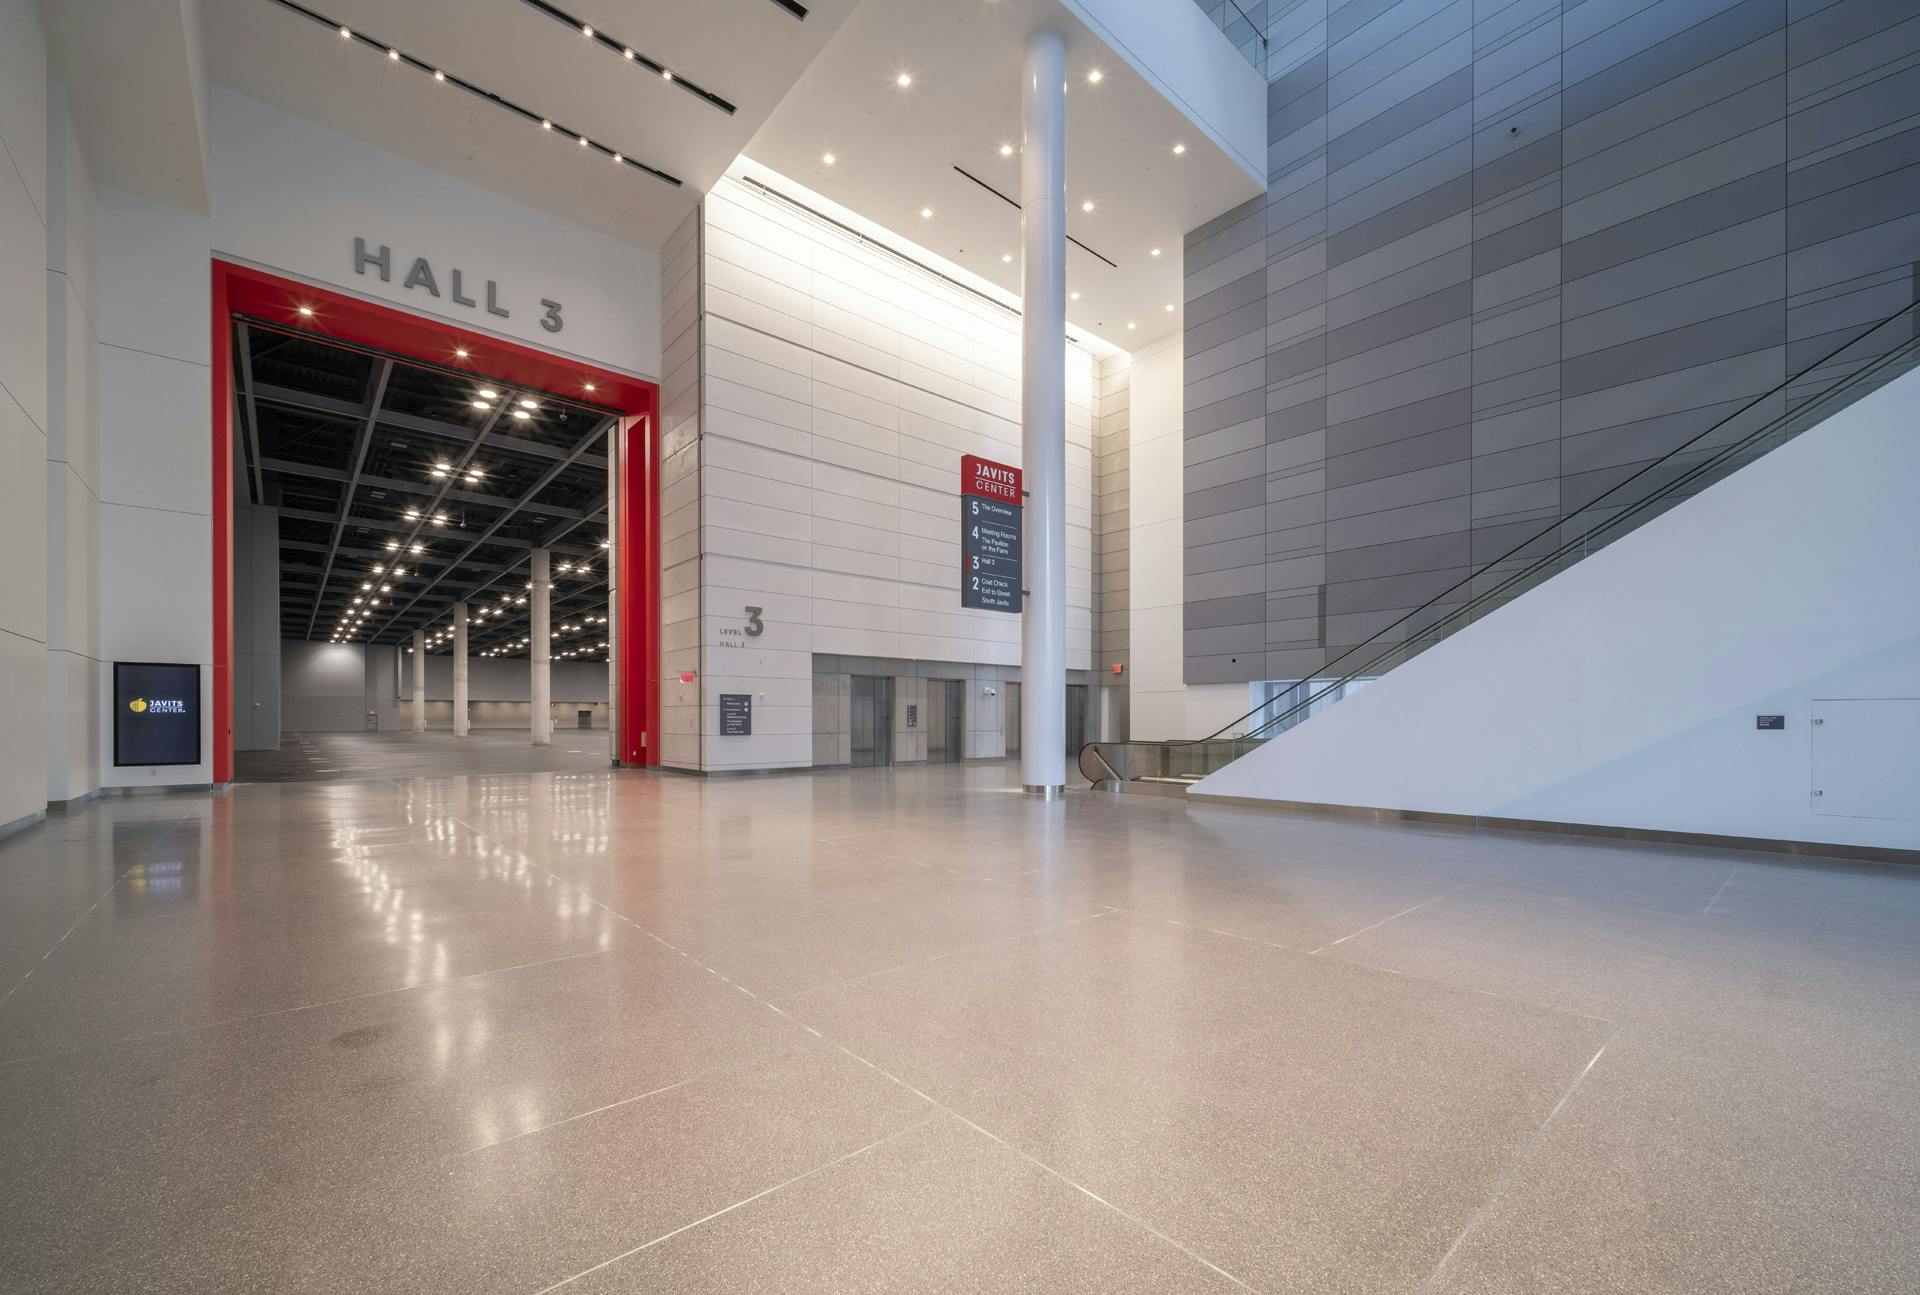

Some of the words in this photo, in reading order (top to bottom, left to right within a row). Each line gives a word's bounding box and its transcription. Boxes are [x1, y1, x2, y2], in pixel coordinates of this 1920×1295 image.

[354, 236, 510, 319] HALL
[540, 297, 563, 333] 3
[976, 463, 1015, 484] JAVITS
[976, 480, 1016, 499] CENTER
[972, 501, 979, 515] 5
[982, 503, 990, 511] The
[991, 505, 1012, 516] Overview
[972, 525, 979, 540] 4
[981, 527, 1000, 539] Meeting
[1000, 531, 1017, 540] Rooms
[981, 536, 991, 545] The
[972, 555, 980, 570] 3
[981, 557, 991, 565] Hall
[972, 576, 979, 591] 2
[981, 577, 993, 586] Coat
[993, 579, 1009, 589] Check
[981, 587, 991, 595] Exit
[991, 588, 997, 596] to
[997, 589, 1011, 598] Street
[981, 596, 996, 605] South
[719, 628, 742, 636] LEVEL
[744, 605, 764, 637] 3
[719, 640, 738, 649] HALL
